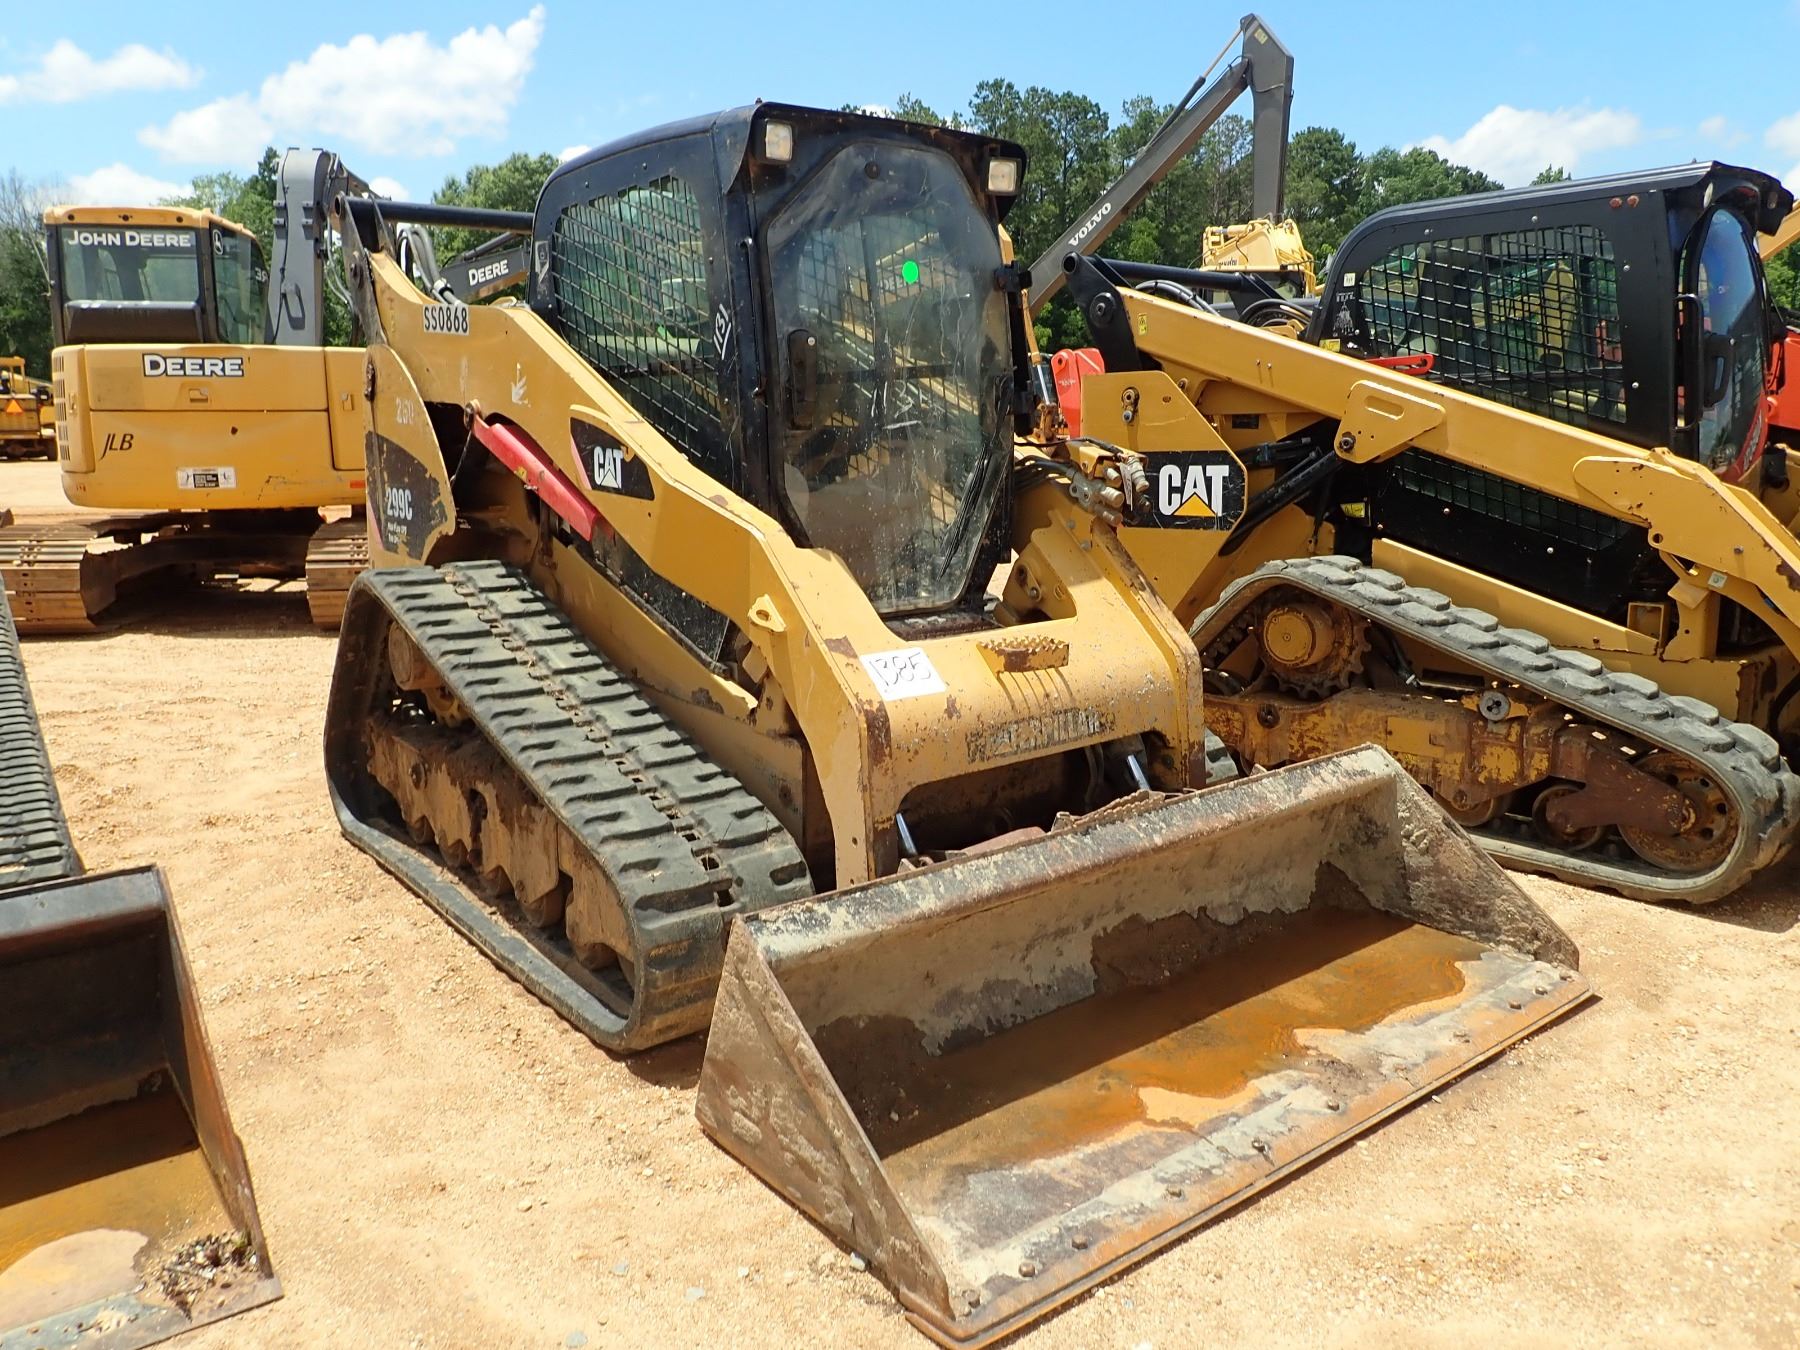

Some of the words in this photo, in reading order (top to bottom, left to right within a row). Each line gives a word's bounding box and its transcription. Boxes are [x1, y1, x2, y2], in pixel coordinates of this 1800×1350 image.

[68, 230, 121, 247] JOHN
[125, 231, 192, 248] DEERE
[1068, 202, 1112, 246] VOLVO
[468, 259, 509, 287] DEERE
[424, 306, 469, 334] SS0868
[142, 353, 244, 378] DEERE
[99, 433, 135, 462] JLB
[593, 445, 624, 489] CAT
[385, 487, 413, 521] 299C
[1158, 464, 1230, 517] CAT
[869, 651, 932, 687] 1385
